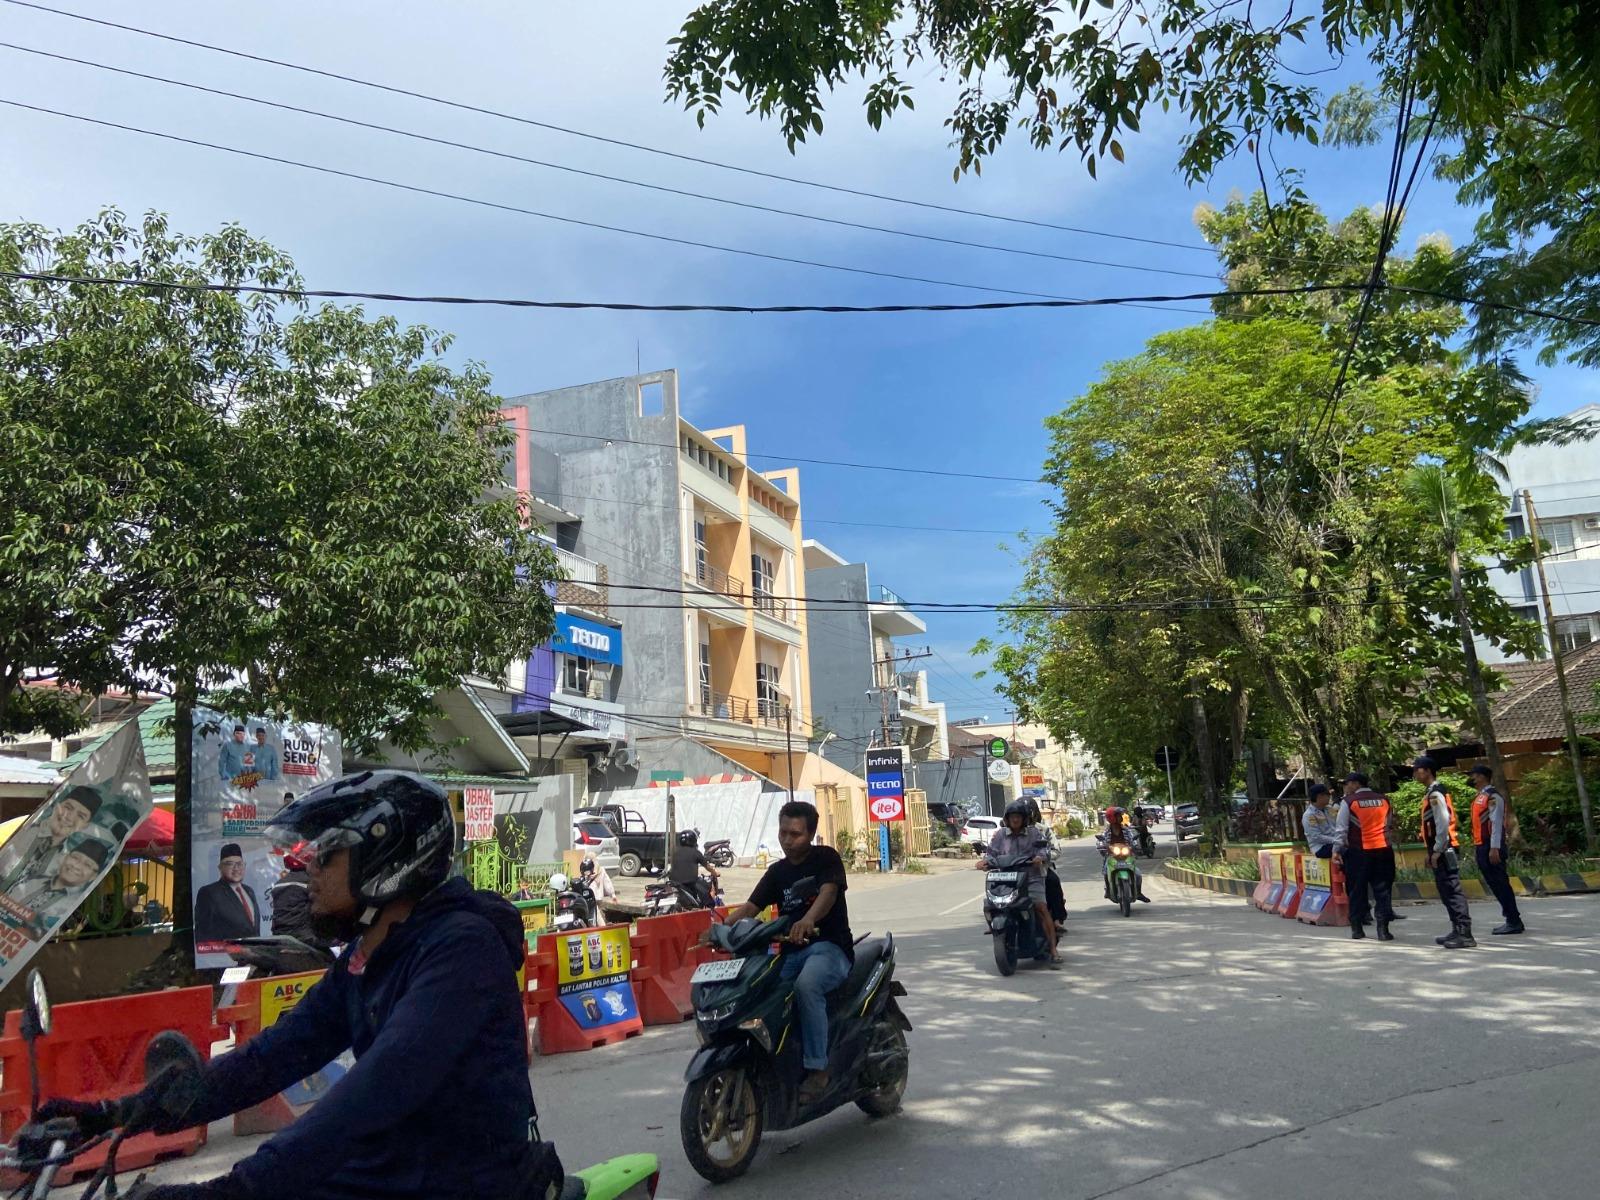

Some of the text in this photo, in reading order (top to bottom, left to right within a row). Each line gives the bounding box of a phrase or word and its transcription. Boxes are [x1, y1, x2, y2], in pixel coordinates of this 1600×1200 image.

[284, 739, 316, 752] RUDY
[243, 752, 254, 765] 2
[868, 756, 899, 766] Infinix
[870, 780, 900, 790] TECNO
[465, 788, 494, 805] OBRAL
[877, 802, 896, 813] itel
[588, 937, 601, 946] ABC
[273, 983, 303, 998] ABC
[561, 986, 572, 994] SAT
[593, 978, 610, 988] POLDA
